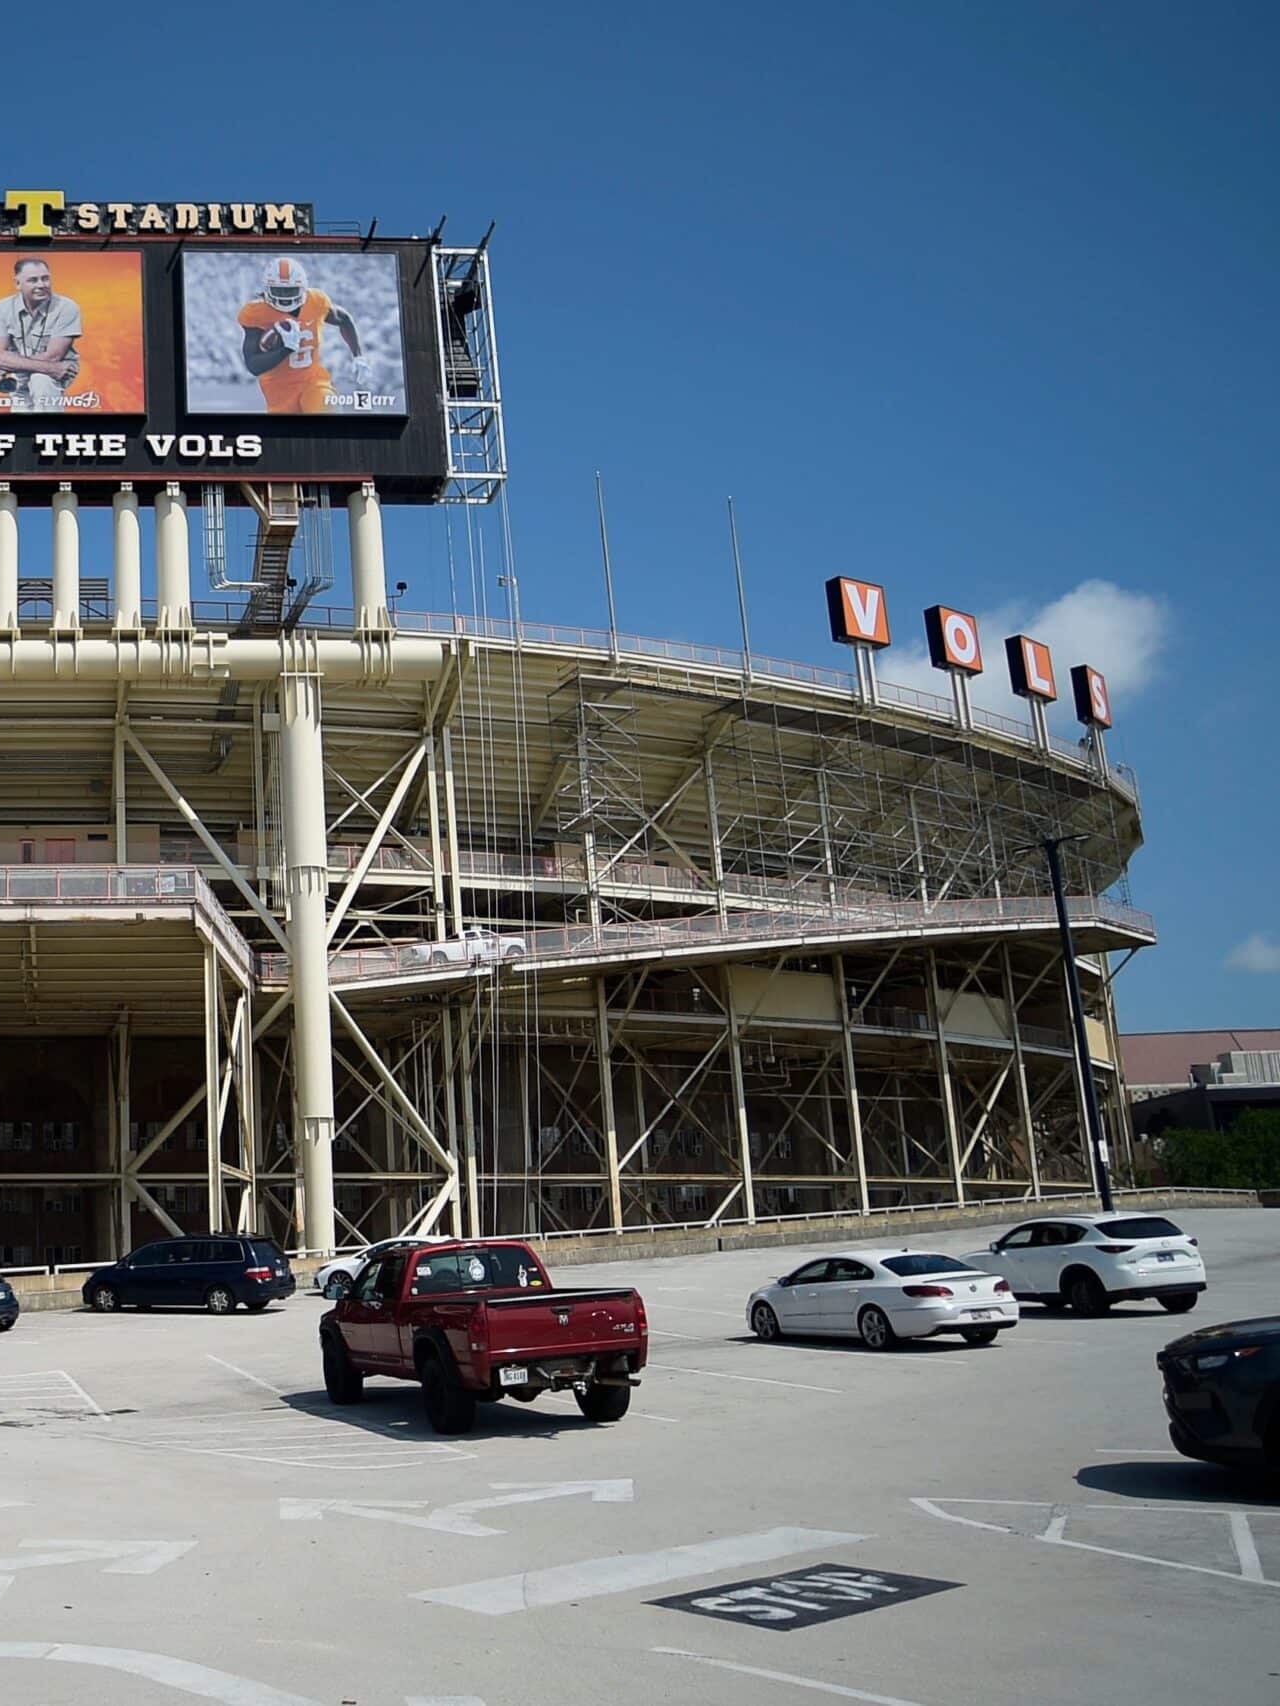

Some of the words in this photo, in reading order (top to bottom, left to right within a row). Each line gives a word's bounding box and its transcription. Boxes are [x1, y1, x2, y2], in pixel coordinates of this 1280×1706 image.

[6, 190, 65, 237] T
[78, 203, 296, 230] STADIUM
[324, 395, 353, 405] FOOD
[372, 395, 396, 406] CITY
[35, 434, 127, 457] THE
[146, 434, 263, 458] VOLS
